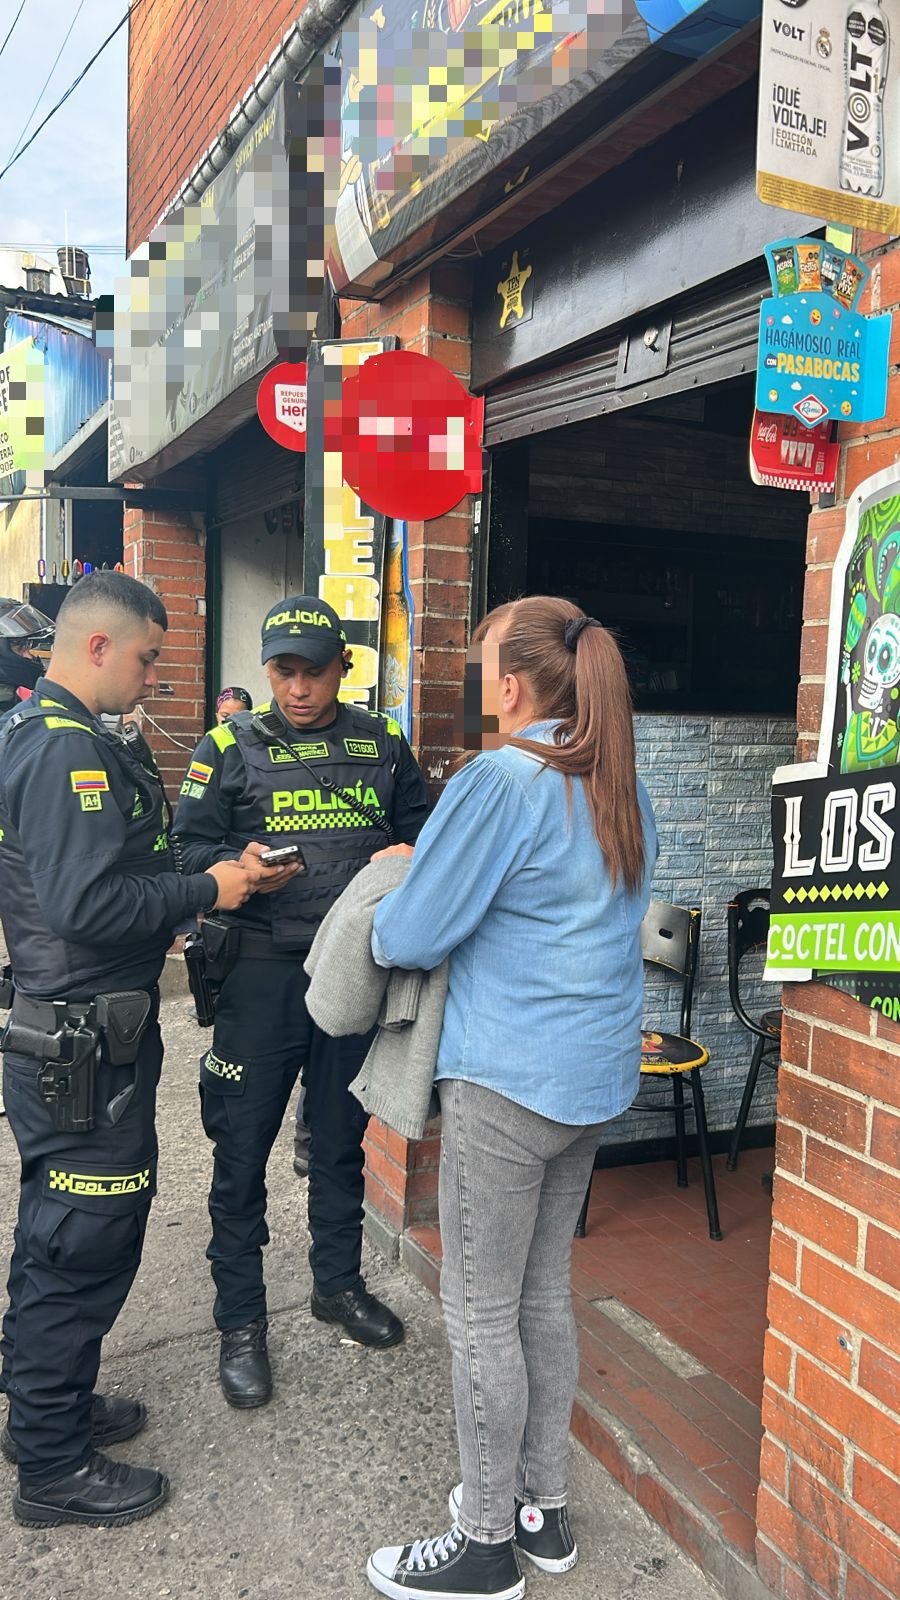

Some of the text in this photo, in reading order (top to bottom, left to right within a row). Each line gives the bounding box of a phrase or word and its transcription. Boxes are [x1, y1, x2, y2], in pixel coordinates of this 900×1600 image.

[773, 19, 806, 41] VOLT
[773, 83, 800, 109] ¡QUÉ
[773, 104, 827, 138] VOLTAJE!
[775, 138, 817, 157] LIMITADA
[776, 128, 813, 147] EDICIÓN
[765, 328, 860, 359] HAGÁMOSLO REAL
[766, 352, 860, 382] CON PASABOCAS
[265, 609, 332, 631] POLICÍA
[272, 779, 380, 813] POLICÍA
[782, 782, 897, 877] LOS
[75, 1179, 136, 1192] POLCÍA
